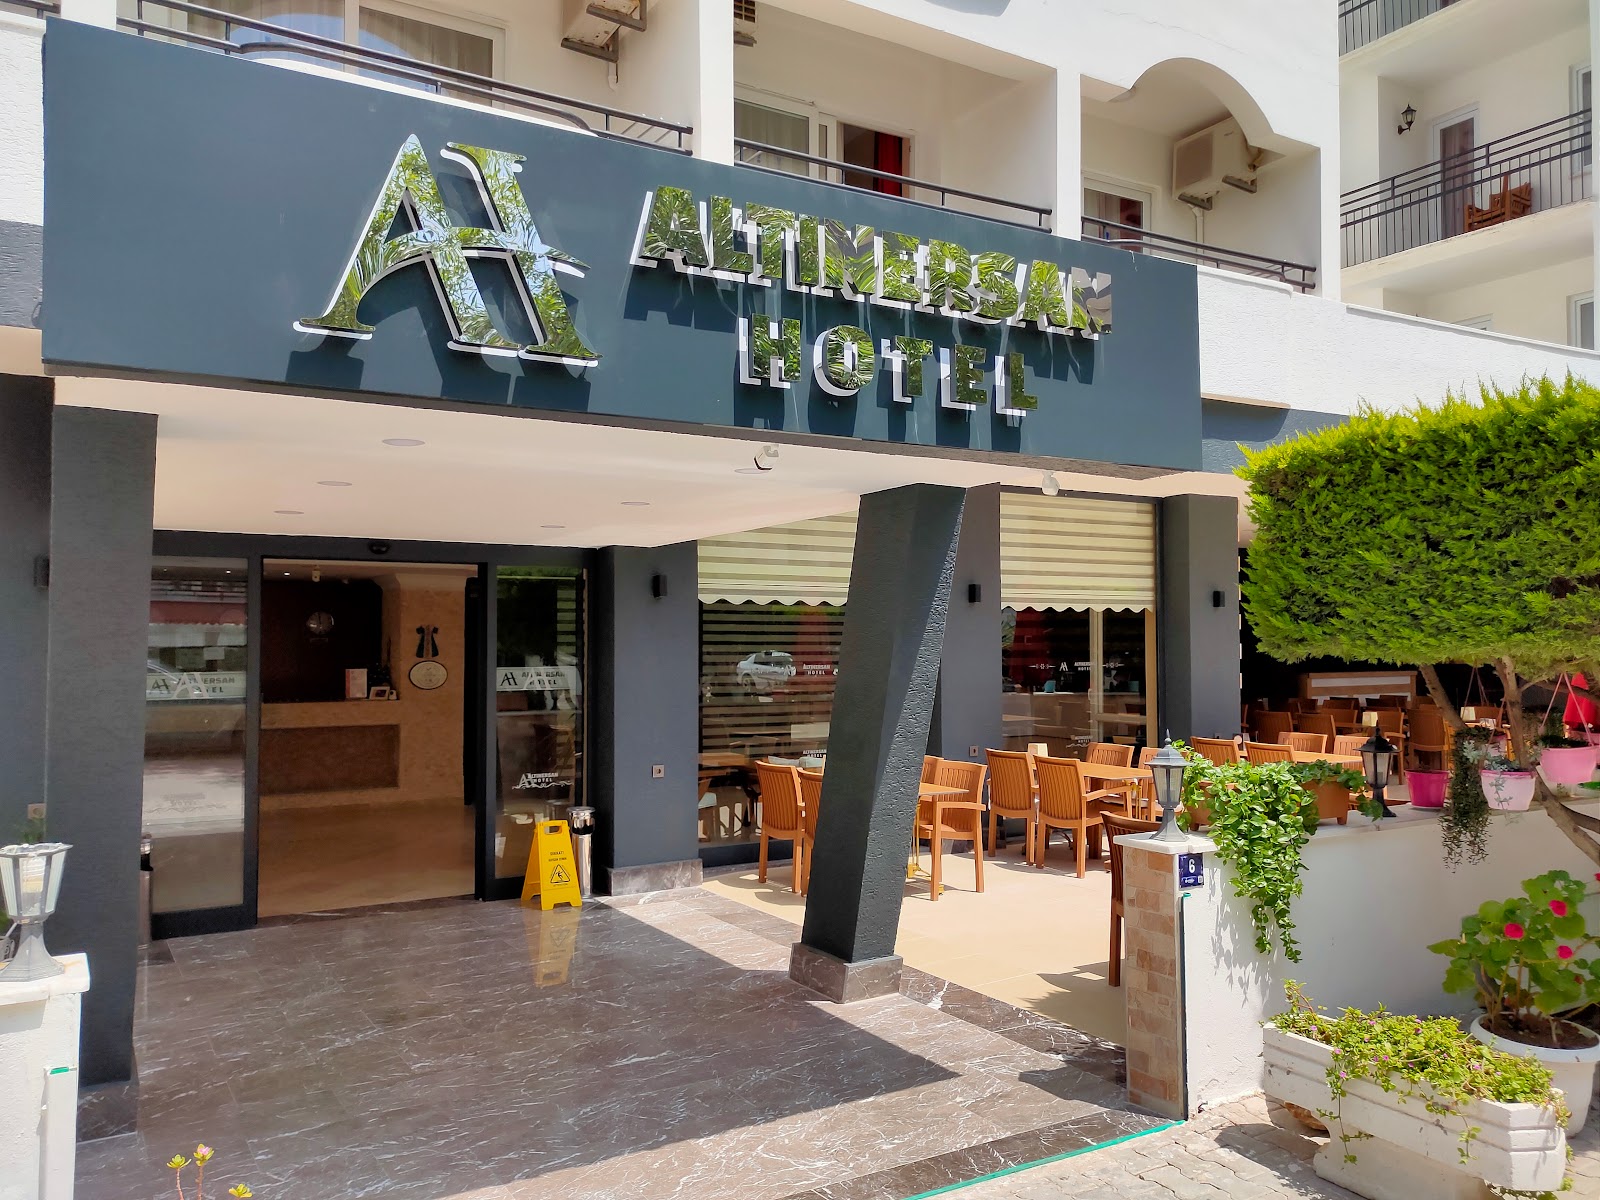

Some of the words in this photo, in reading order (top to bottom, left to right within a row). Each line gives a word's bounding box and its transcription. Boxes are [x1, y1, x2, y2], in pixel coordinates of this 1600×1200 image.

[630, 185, 1113, 341] ALTINERSAN
[739, 313, 1038, 417] HOTEL
[1188, 858, 1196, 873] 6
